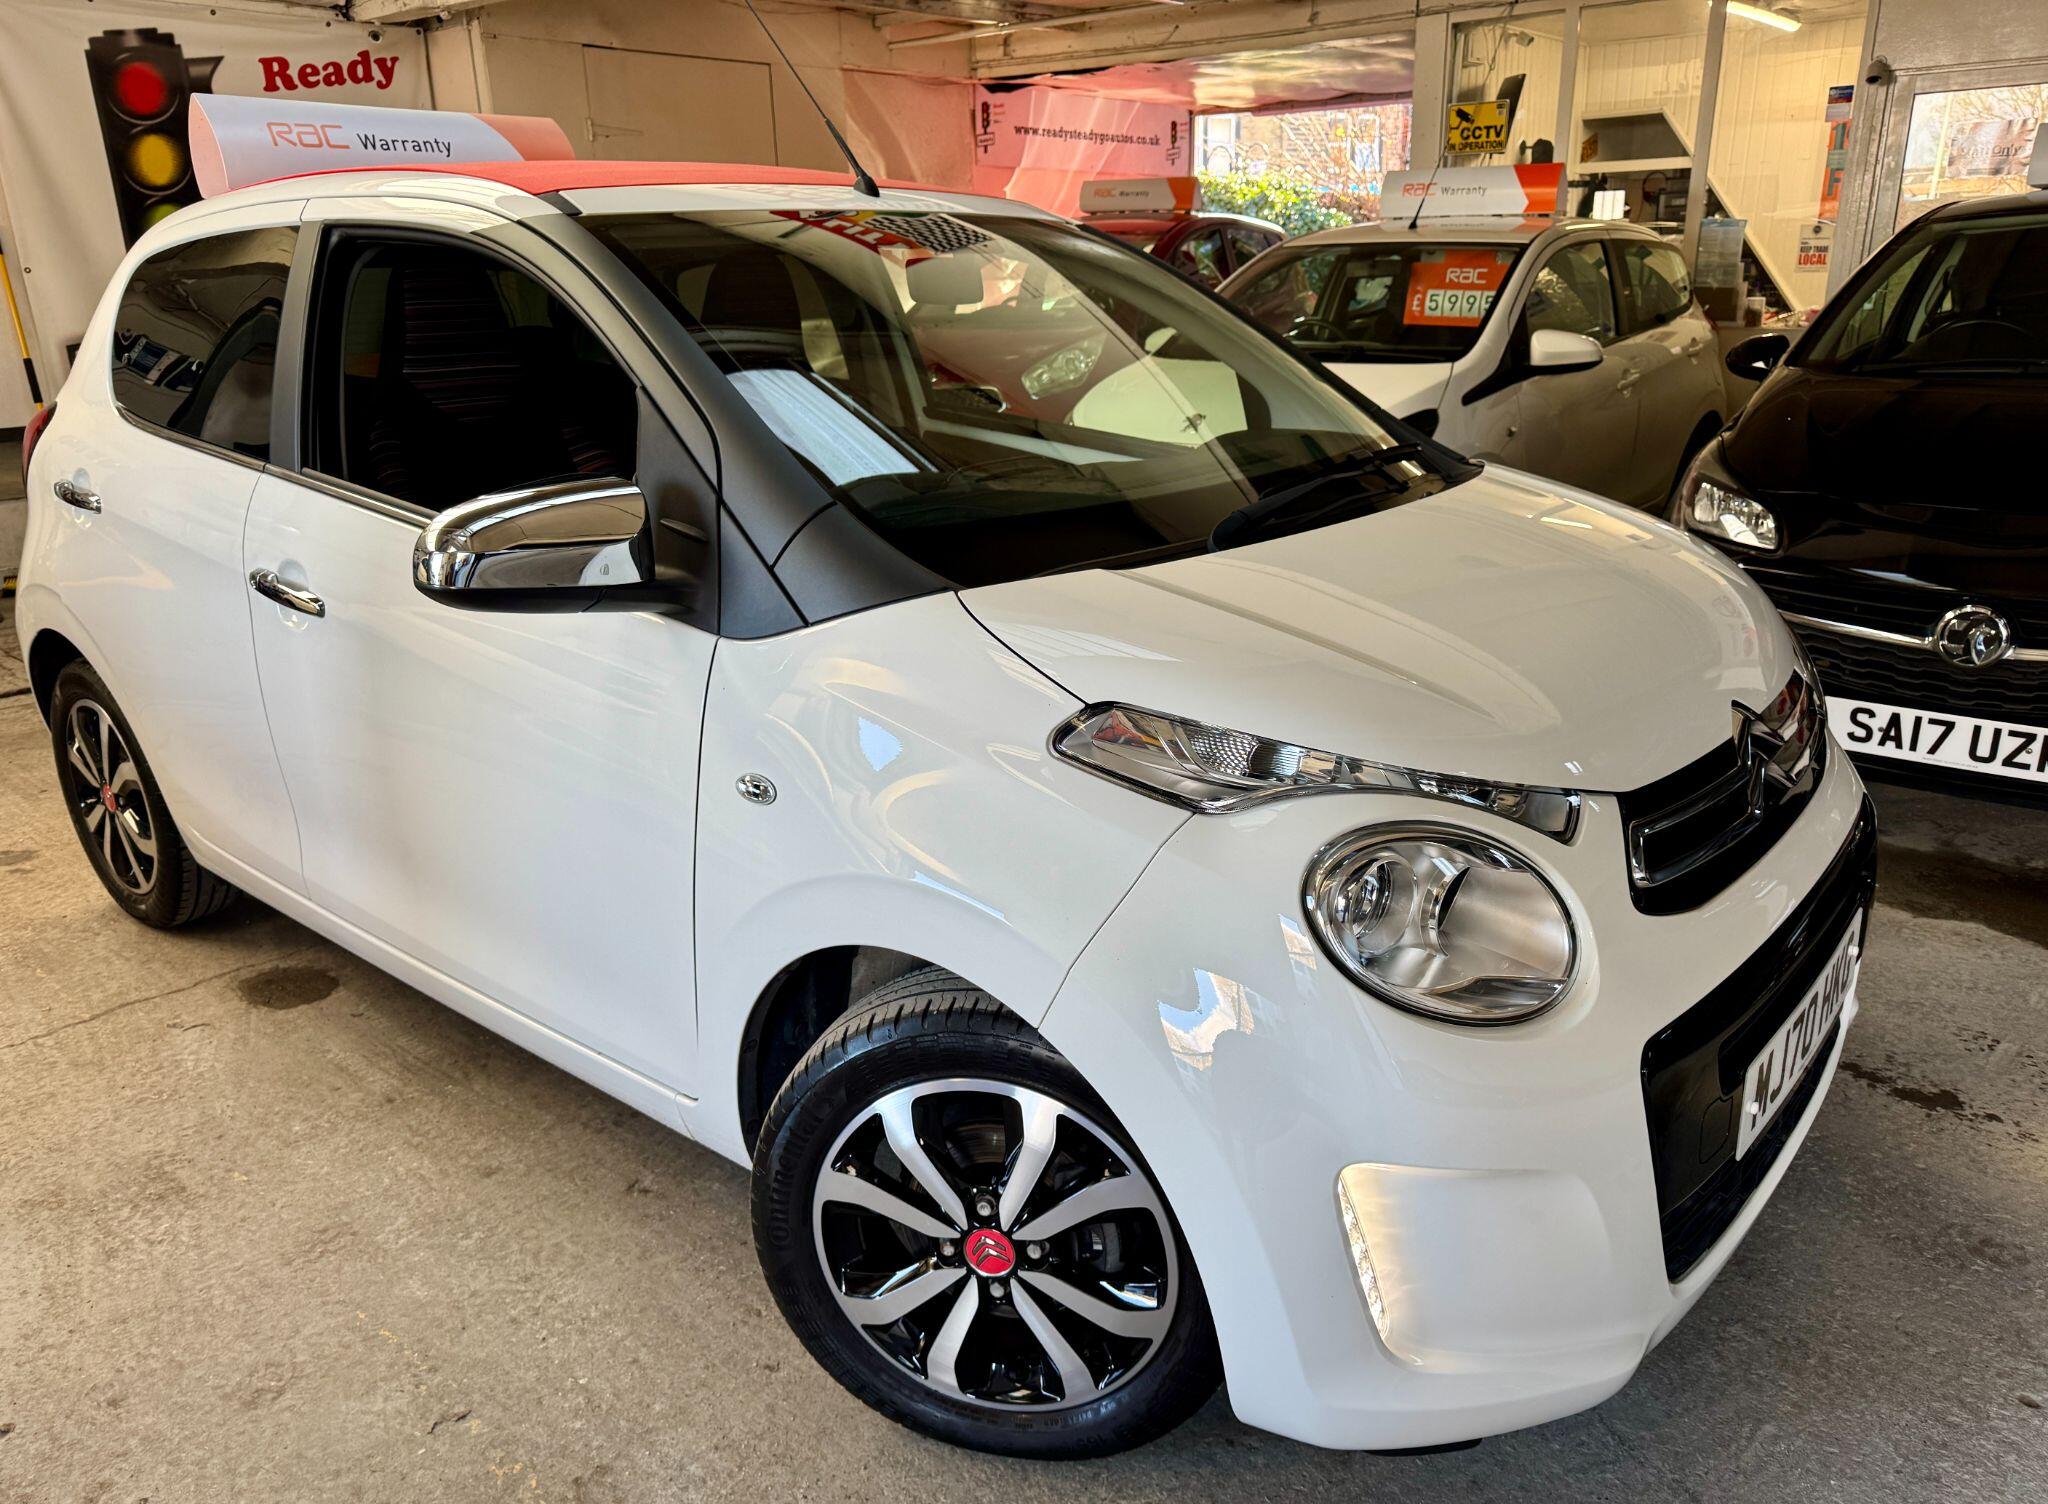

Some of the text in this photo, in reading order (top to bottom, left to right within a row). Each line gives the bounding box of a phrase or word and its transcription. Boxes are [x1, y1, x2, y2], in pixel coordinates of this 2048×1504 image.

[258, 50, 400, 92] Ready
[1014, 124, 1161, 146] www.readysteadygoautos.co.uk
[1460, 125, 1504, 140] CCTV
[356, 133, 452, 158] Warranty
[1448, 139, 1505, 152] IN OPERATION
[1440, 185, 1487, 197] Warranty
[1813, 245, 1829, 253] TRADE
[1798, 253, 1827, 265] LOCAL
[1846, 706, 1956, 755] SA17
[1750, 990, 1819, 1132] MJ70
